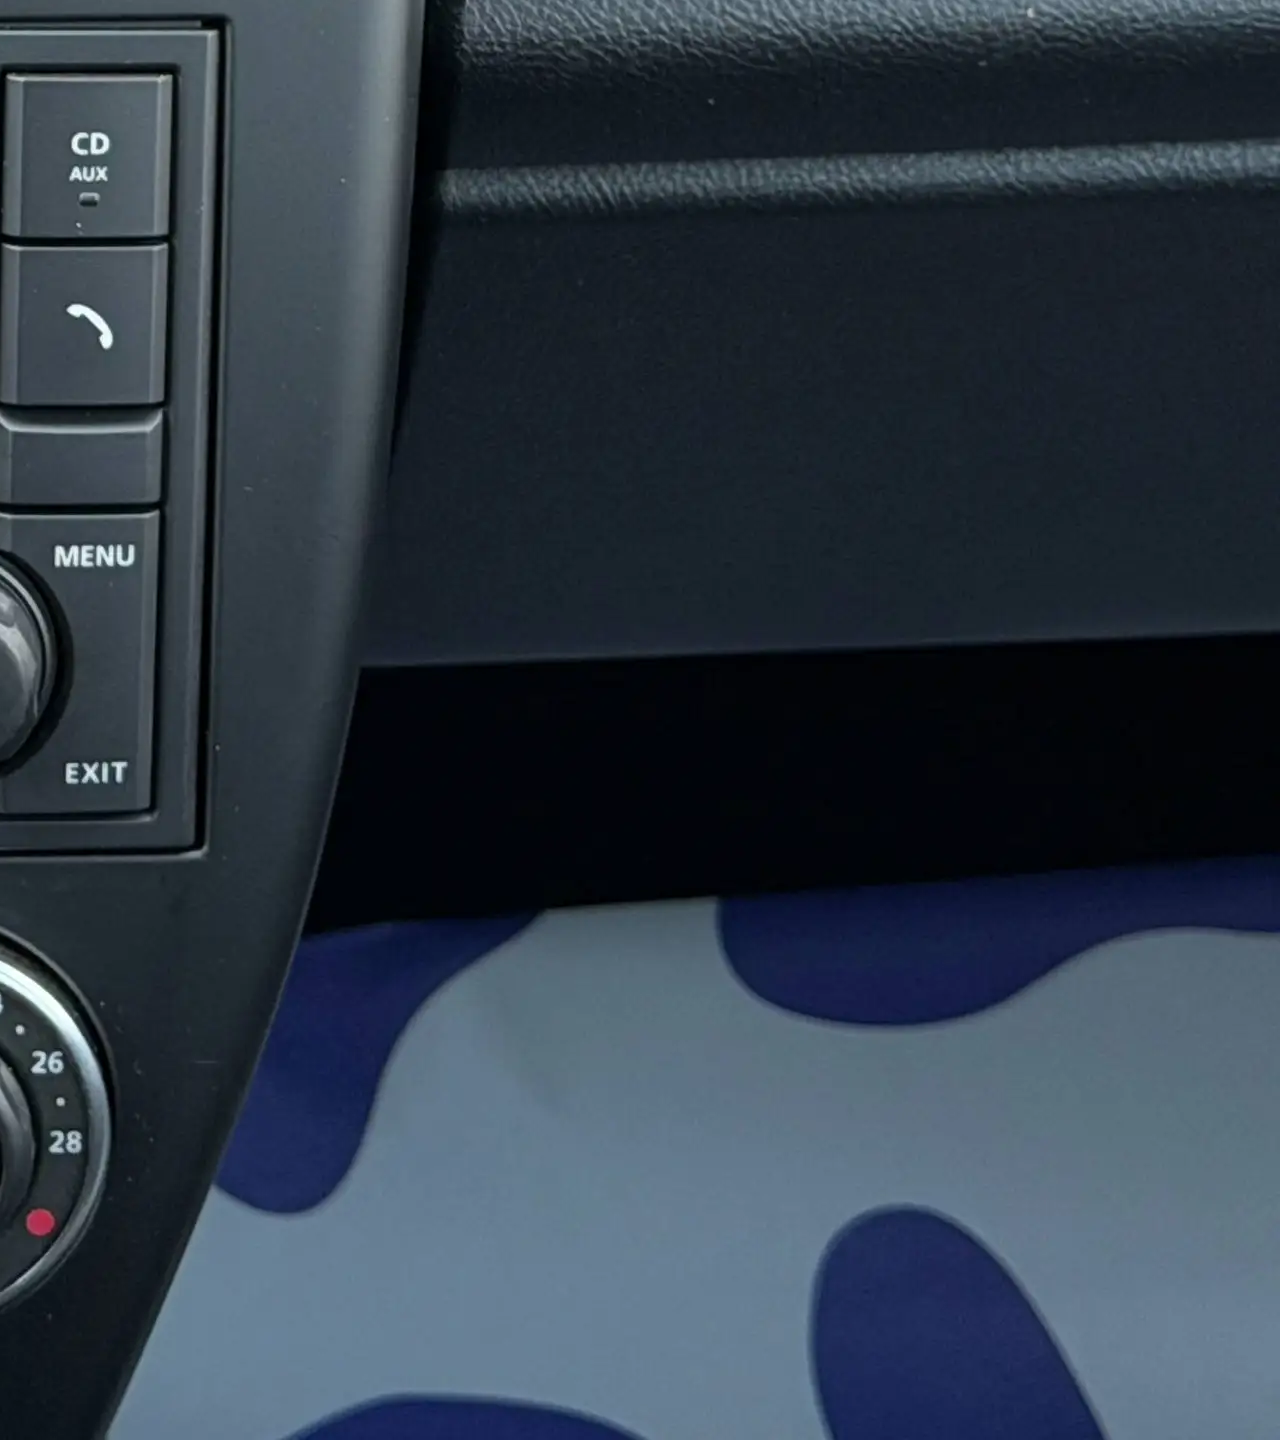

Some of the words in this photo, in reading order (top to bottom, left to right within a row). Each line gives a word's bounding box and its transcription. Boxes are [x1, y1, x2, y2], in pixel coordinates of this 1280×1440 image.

[70, 131, 111, 156] CD
[68, 166, 109, 183] AUX
[53, 545, 136, 568] MENU
[64, 761, 128, 784] EXIT
[31, 1050, 64, 1075] 26
[48, 1129, 83, 1154] 28
